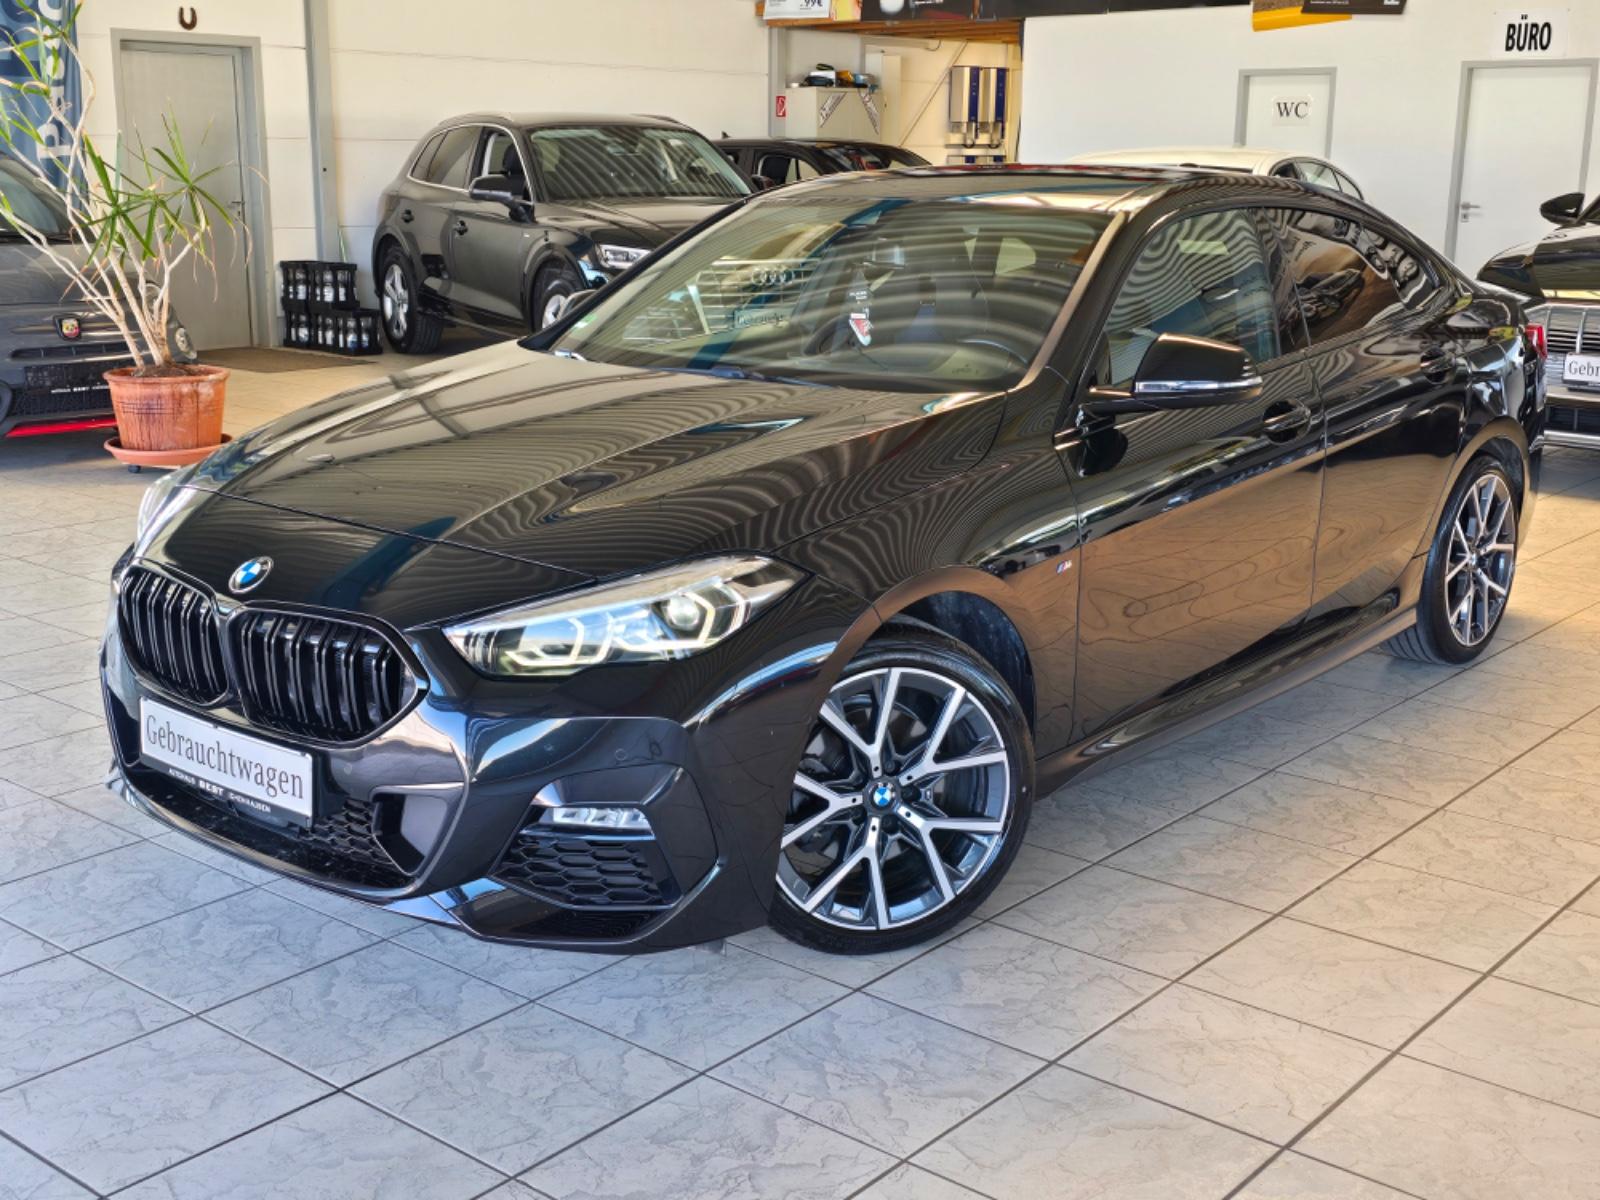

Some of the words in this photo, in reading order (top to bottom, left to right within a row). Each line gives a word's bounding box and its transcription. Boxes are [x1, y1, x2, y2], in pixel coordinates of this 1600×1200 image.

[1504, 14, 1553, 52] BÜRO
[1275, 101, 1309, 119] WC
[145, 713, 304, 800] Gebrauchtwagen
